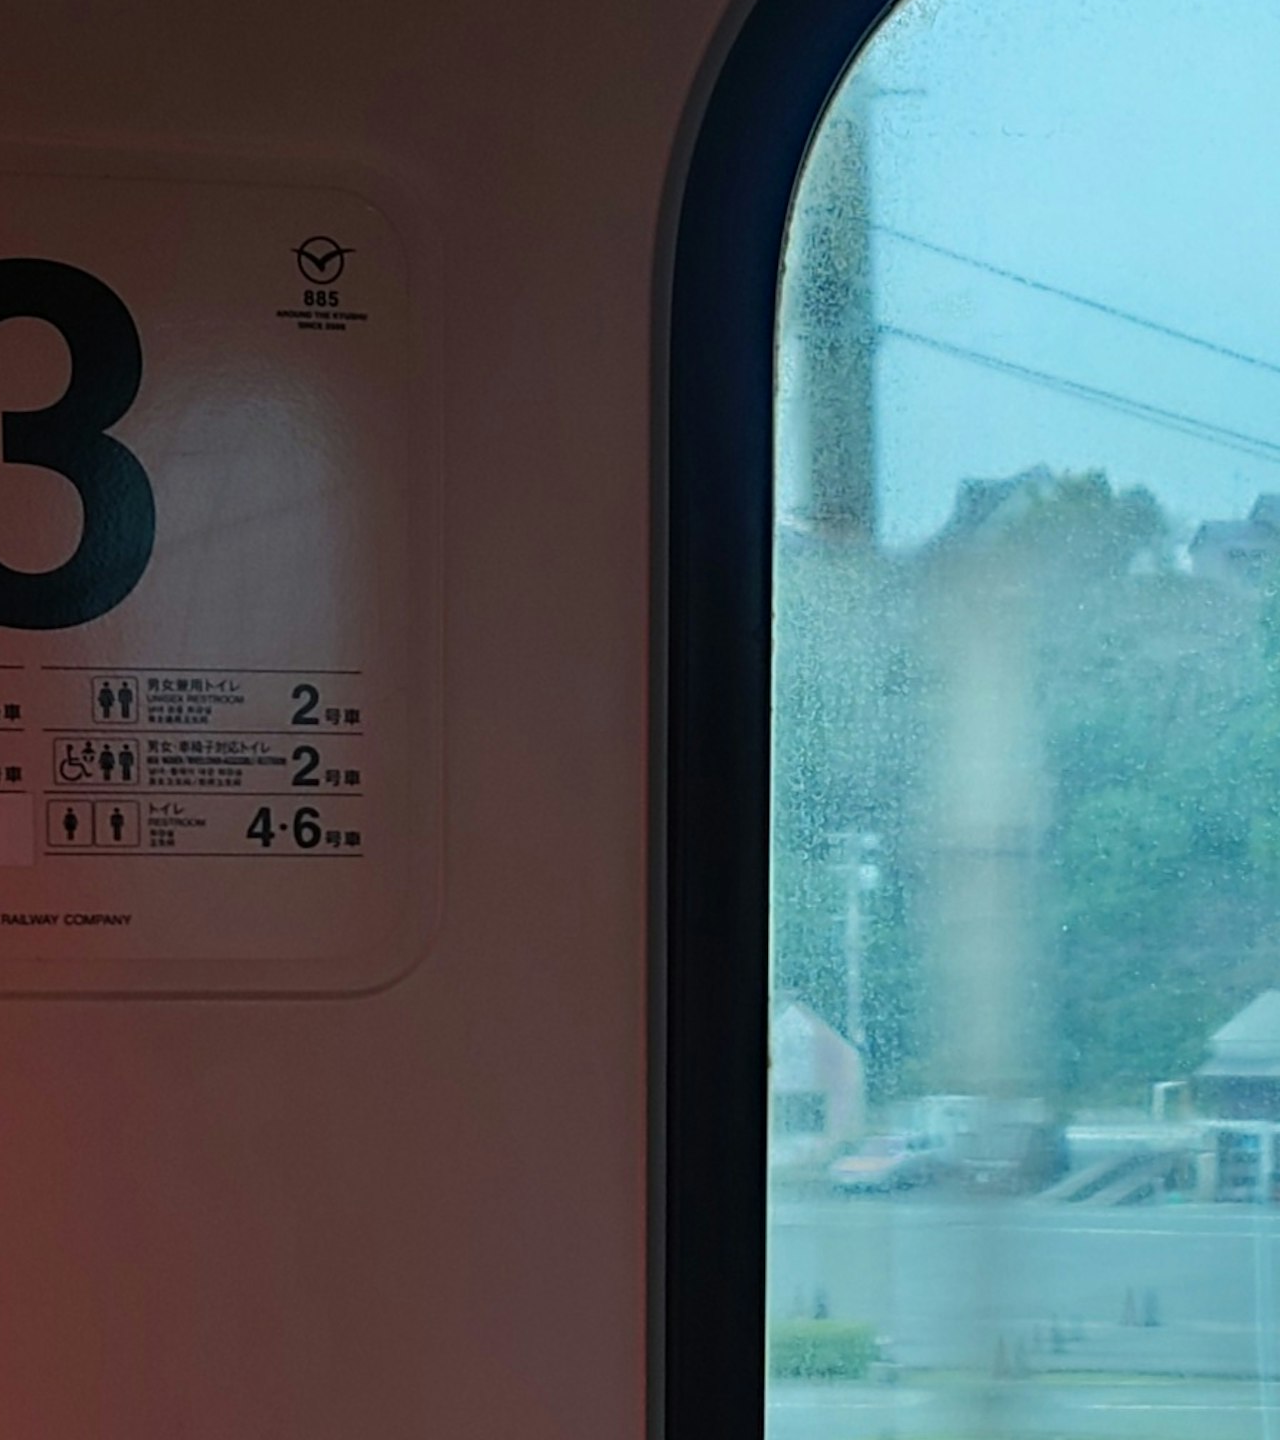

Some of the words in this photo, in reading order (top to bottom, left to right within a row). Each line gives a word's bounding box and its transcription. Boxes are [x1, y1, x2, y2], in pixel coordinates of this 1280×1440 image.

[303, 289, 339, 307] 885
[147, 678, 241, 692] 男女兼用トイレ
[146, 693, 183, 703] UNISEX
[186, 694, 245, 704] RESTROOM
[148, 802, 185, 816] トイレ
[147, 817, 207, 827] RESTROOM
[0, 913, 60, 926] RAILWAY
[63, 913, 132, 926] COMPANY
